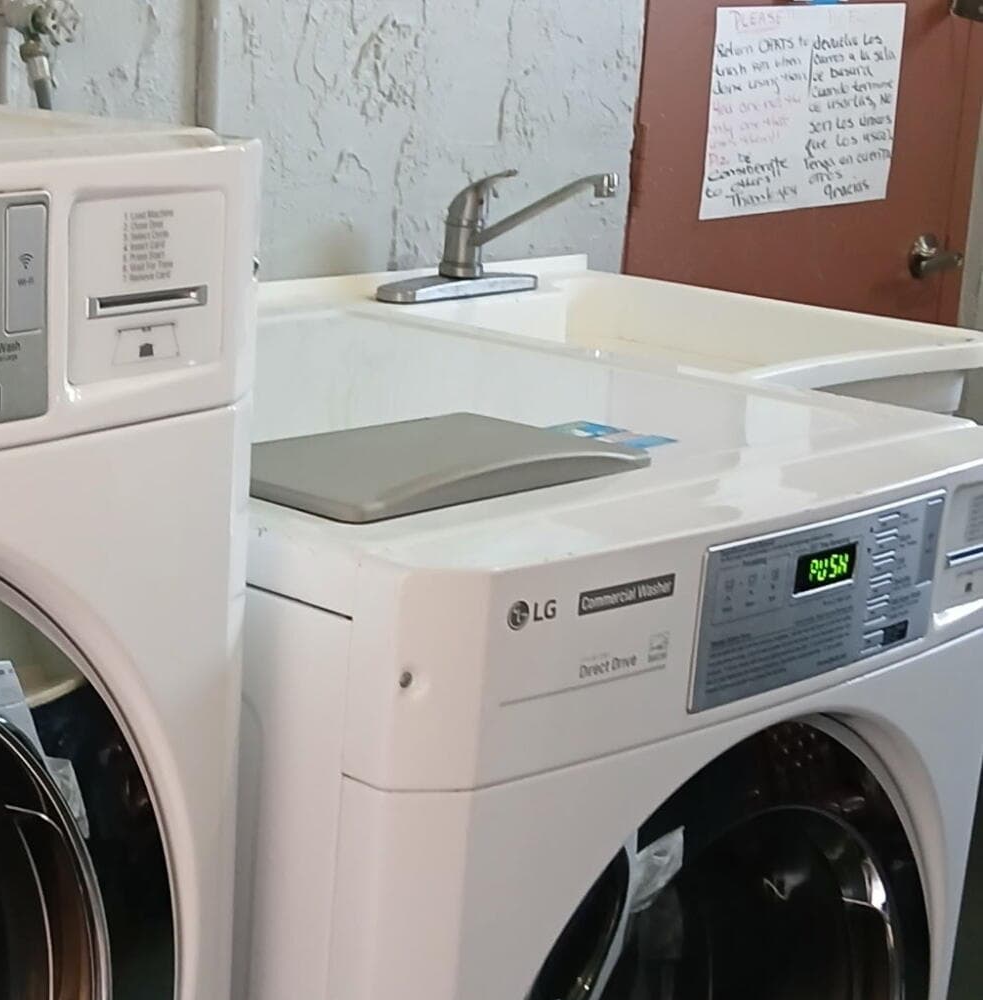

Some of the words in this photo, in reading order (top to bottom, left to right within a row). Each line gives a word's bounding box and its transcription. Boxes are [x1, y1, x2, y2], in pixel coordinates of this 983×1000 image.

[808, 552, 850, 582] PUSH
[581, 586, 637, 612] Commercial
[637, 579, 673, 599] Washer
[533, 600, 557, 622] LG
